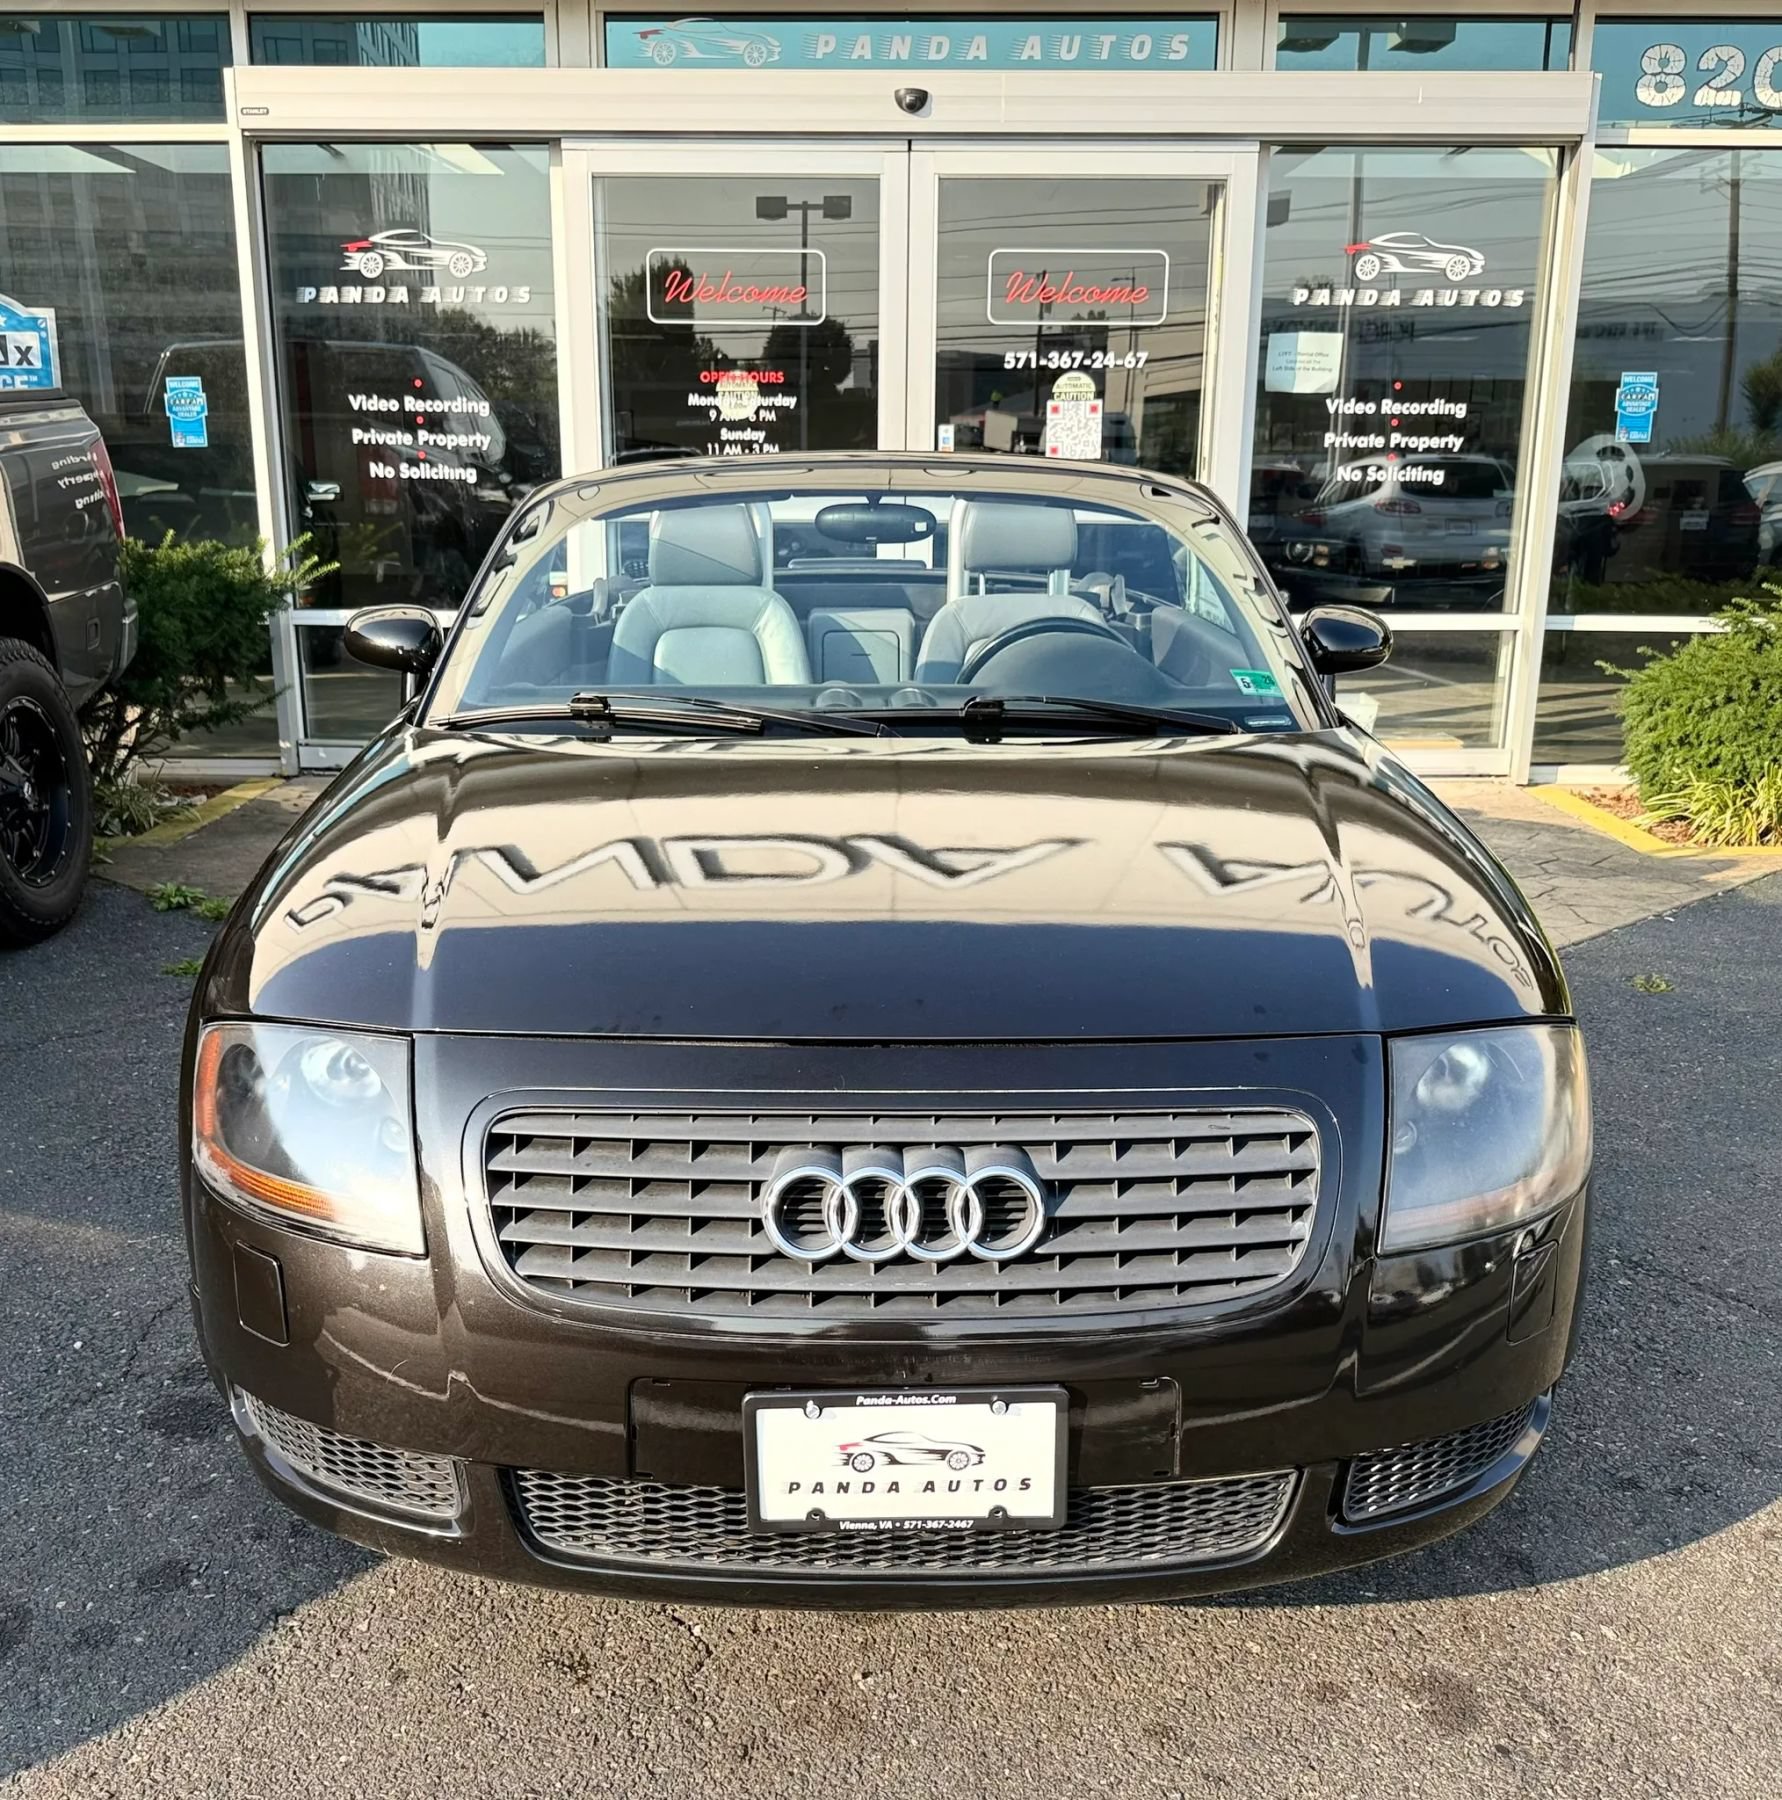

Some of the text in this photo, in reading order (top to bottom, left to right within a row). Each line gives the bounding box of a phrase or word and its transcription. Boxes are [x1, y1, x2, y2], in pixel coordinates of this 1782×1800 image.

[804, 34, 1188, 61] PANDA AUTOS
[296, 286, 531, 303] PANDA AUTOS
[664, 270, 809, 304] Welcome
[1005, 271, 1149, 304] Welcome
[1291, 288, 1524, 307] PANDA AUTOS
[1003, 351, 1149, 369] 571-367-24-67
[739, 371, 785, 384] HOURS
[1053, 391, 1094, 401] CAUTION
[348, 394, 490, 417] Video Recording
[1325, 397, 1467, 418] Video Recording
[709, 409, 718, 421] 9
[759, 409, 777, 422] PM
[351, 428, 491, 450] Private Property
[720, 427, 766, 444] Sunday
[1323, 432, 1464, 452] Private Property
[707, 443, 720, 456] 11
[723, 443, 742, 455] AM
[763, 443, 779, 454] PM
[369, 461, 477, 484] No Soliciting
[1336, 465, 1445, 485] No Soliciting
[1240, 677, 1252, 689] 5
[856, 1394, 957, 1406] Panda-Autos.Com
[786, 1478, 1031, 1494] PANDA AUTOS
[839, 1520, 975, 1530] Vienna, VA 571-367-2467
